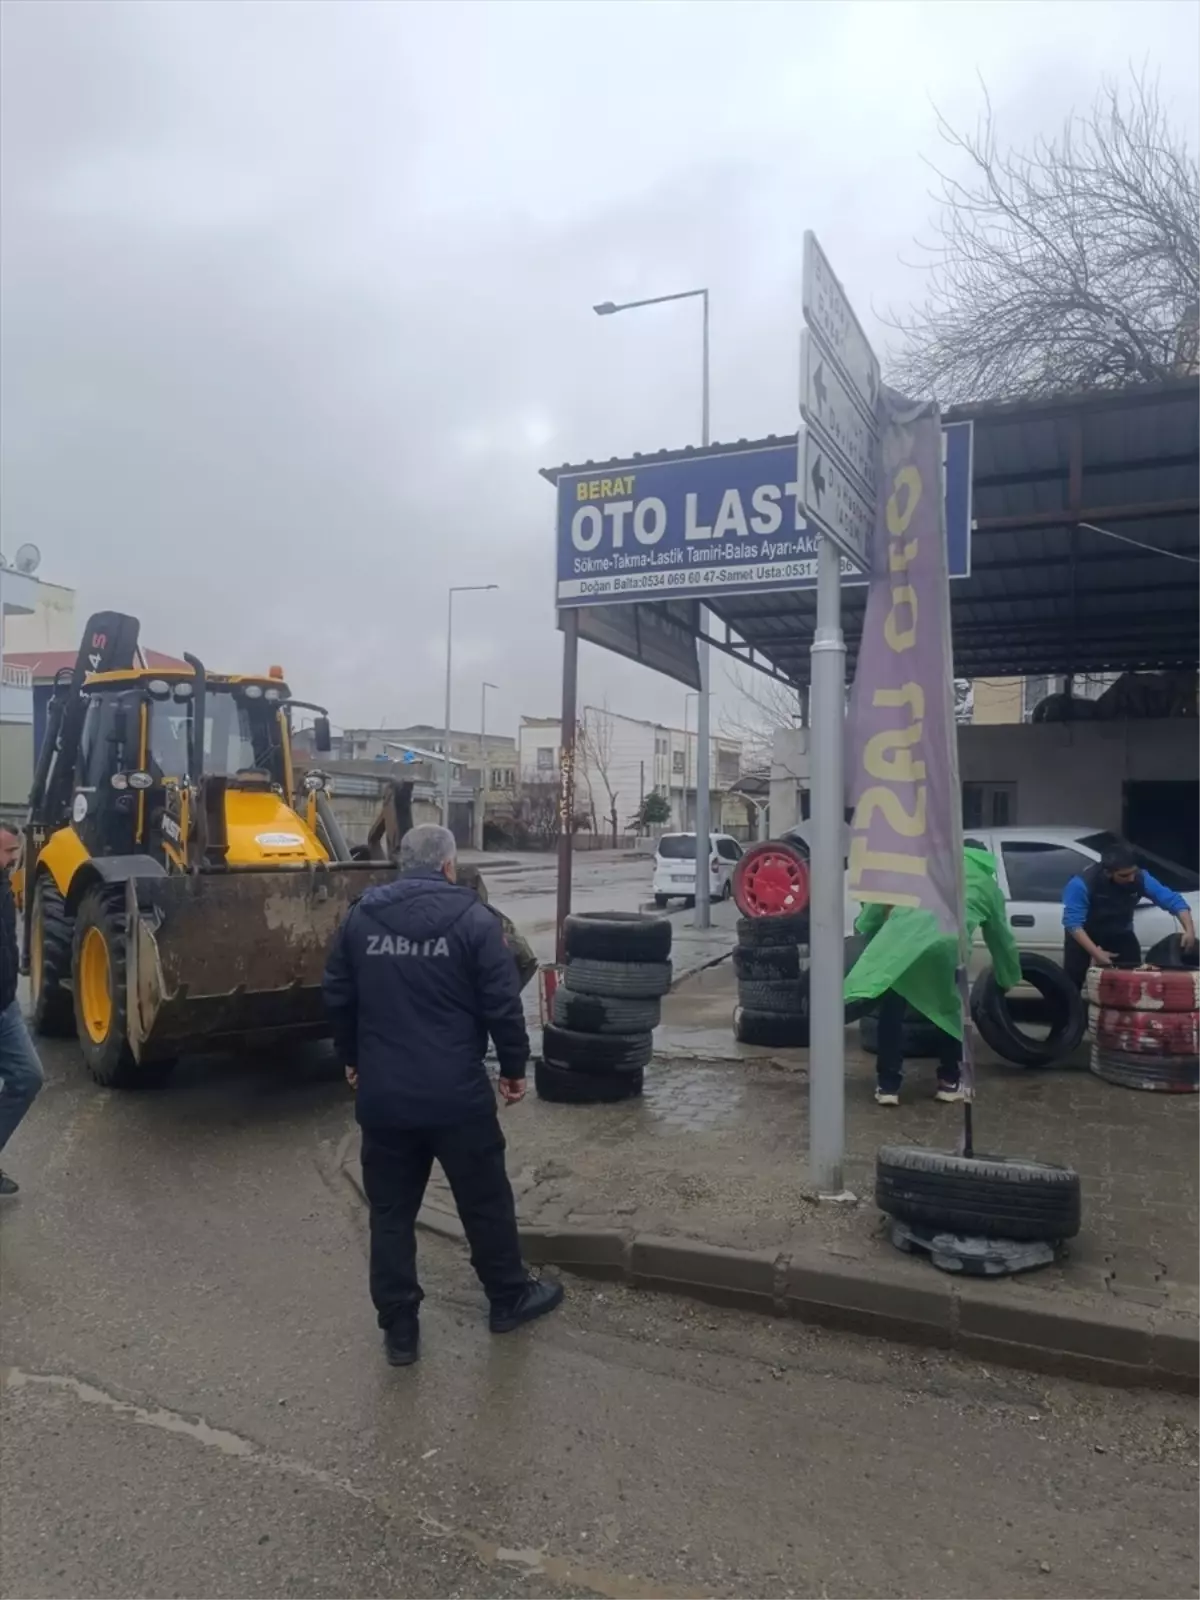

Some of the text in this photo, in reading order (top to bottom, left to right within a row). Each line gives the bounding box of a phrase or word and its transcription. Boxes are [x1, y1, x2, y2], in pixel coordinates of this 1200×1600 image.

[576, 475, 636, 501] BERAT
[571, 496, 667, 552] OTO
[667, 572, 686, 586] 069
[688, 571, 701, 584] 60
[365, 934, 450, 957] ZABITA
